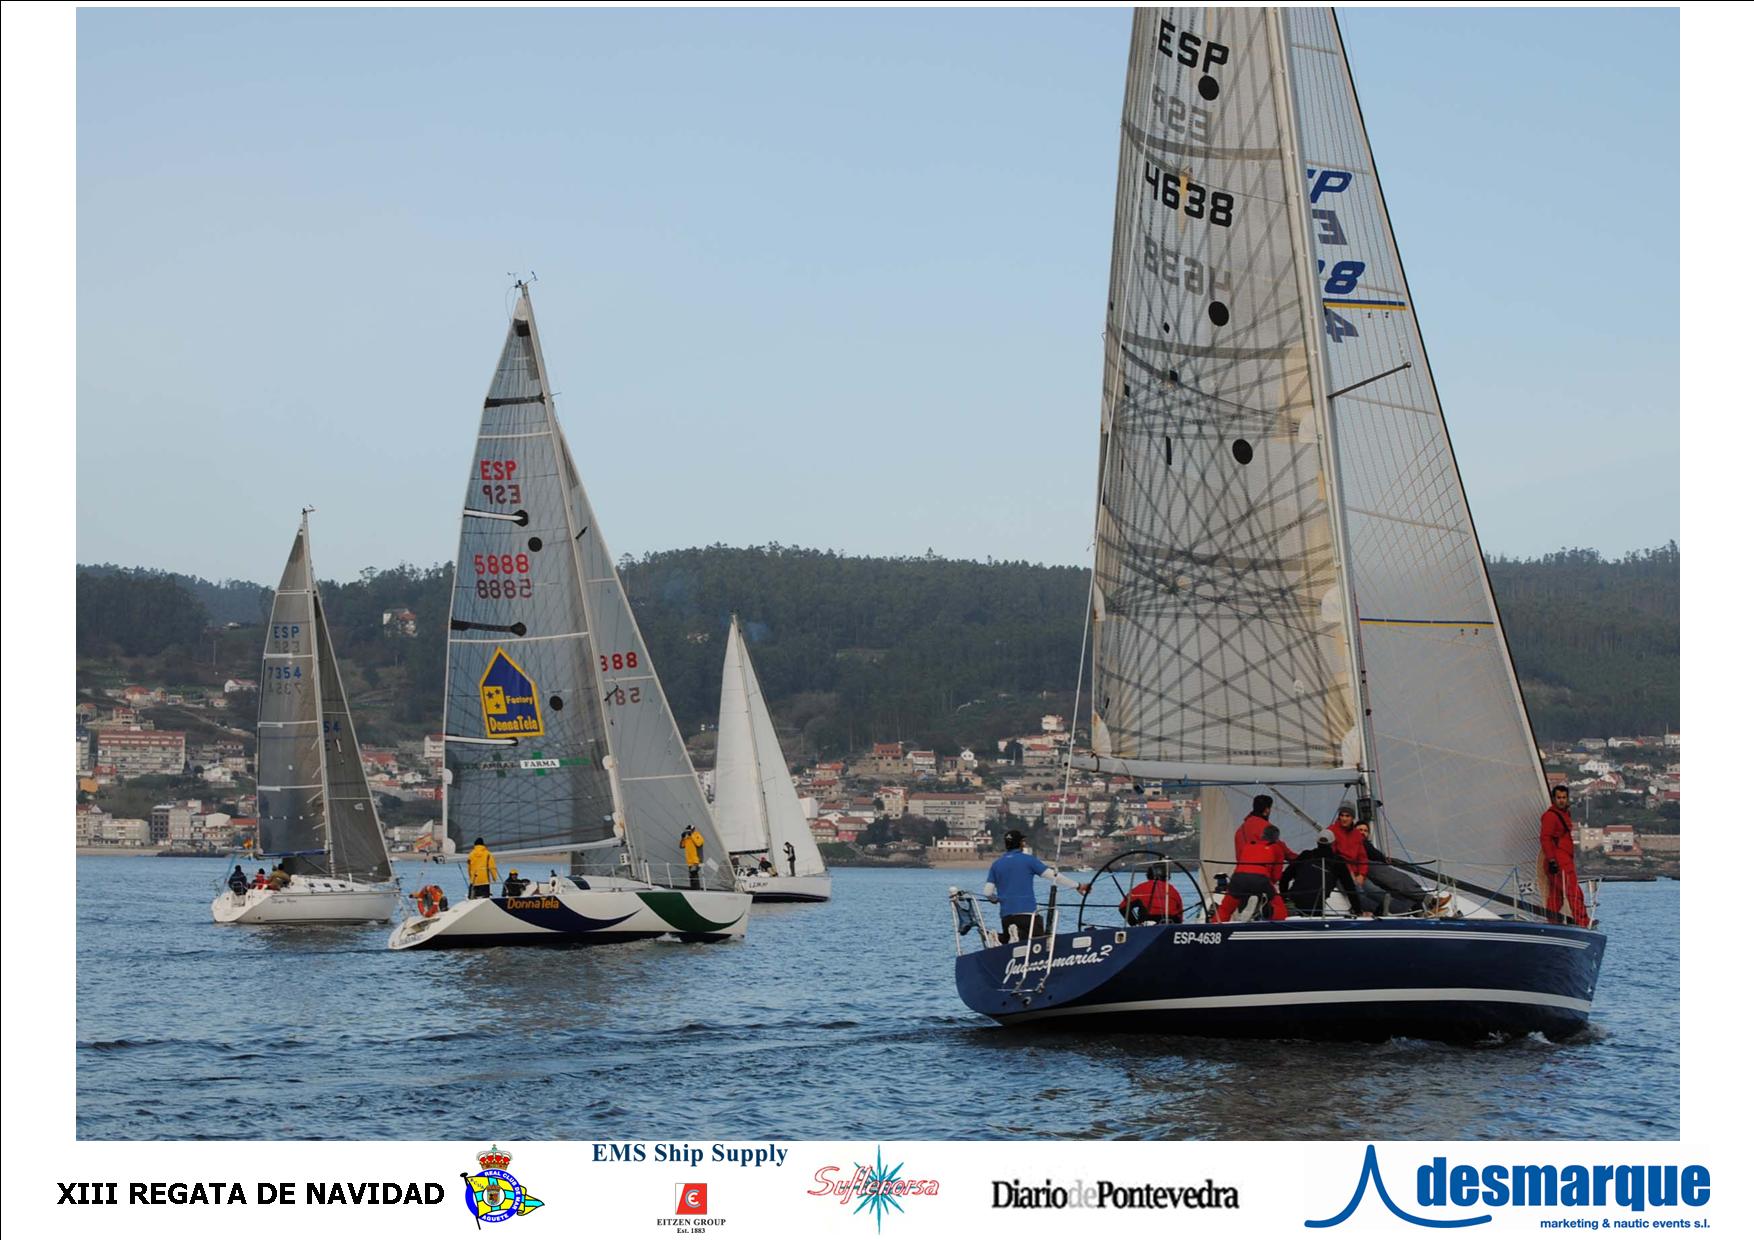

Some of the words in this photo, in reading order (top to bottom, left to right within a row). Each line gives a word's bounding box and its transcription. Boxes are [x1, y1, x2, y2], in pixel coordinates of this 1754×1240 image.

[1157, 19, 1229, 73] ESP
[1145, 160, 1234, 227] 4638
[1307, 168, 1353, 203] P
[1317, 259, 1366, 294] 8
[480, 461, 516, 480] ESP
[474, 554, 529, 575] 5888
[273, 626, 300, 639] ESP
[267, 667, 302, 679] 7354
[506, 695, 534, 705] Factory
[489, 715, 539, 732] DonnaTela
[525, 760, 557, 768] FARMA
[507, 897, 560, 910] DonnaTela
[1173, 931, 1222, 945] ESP-4638
